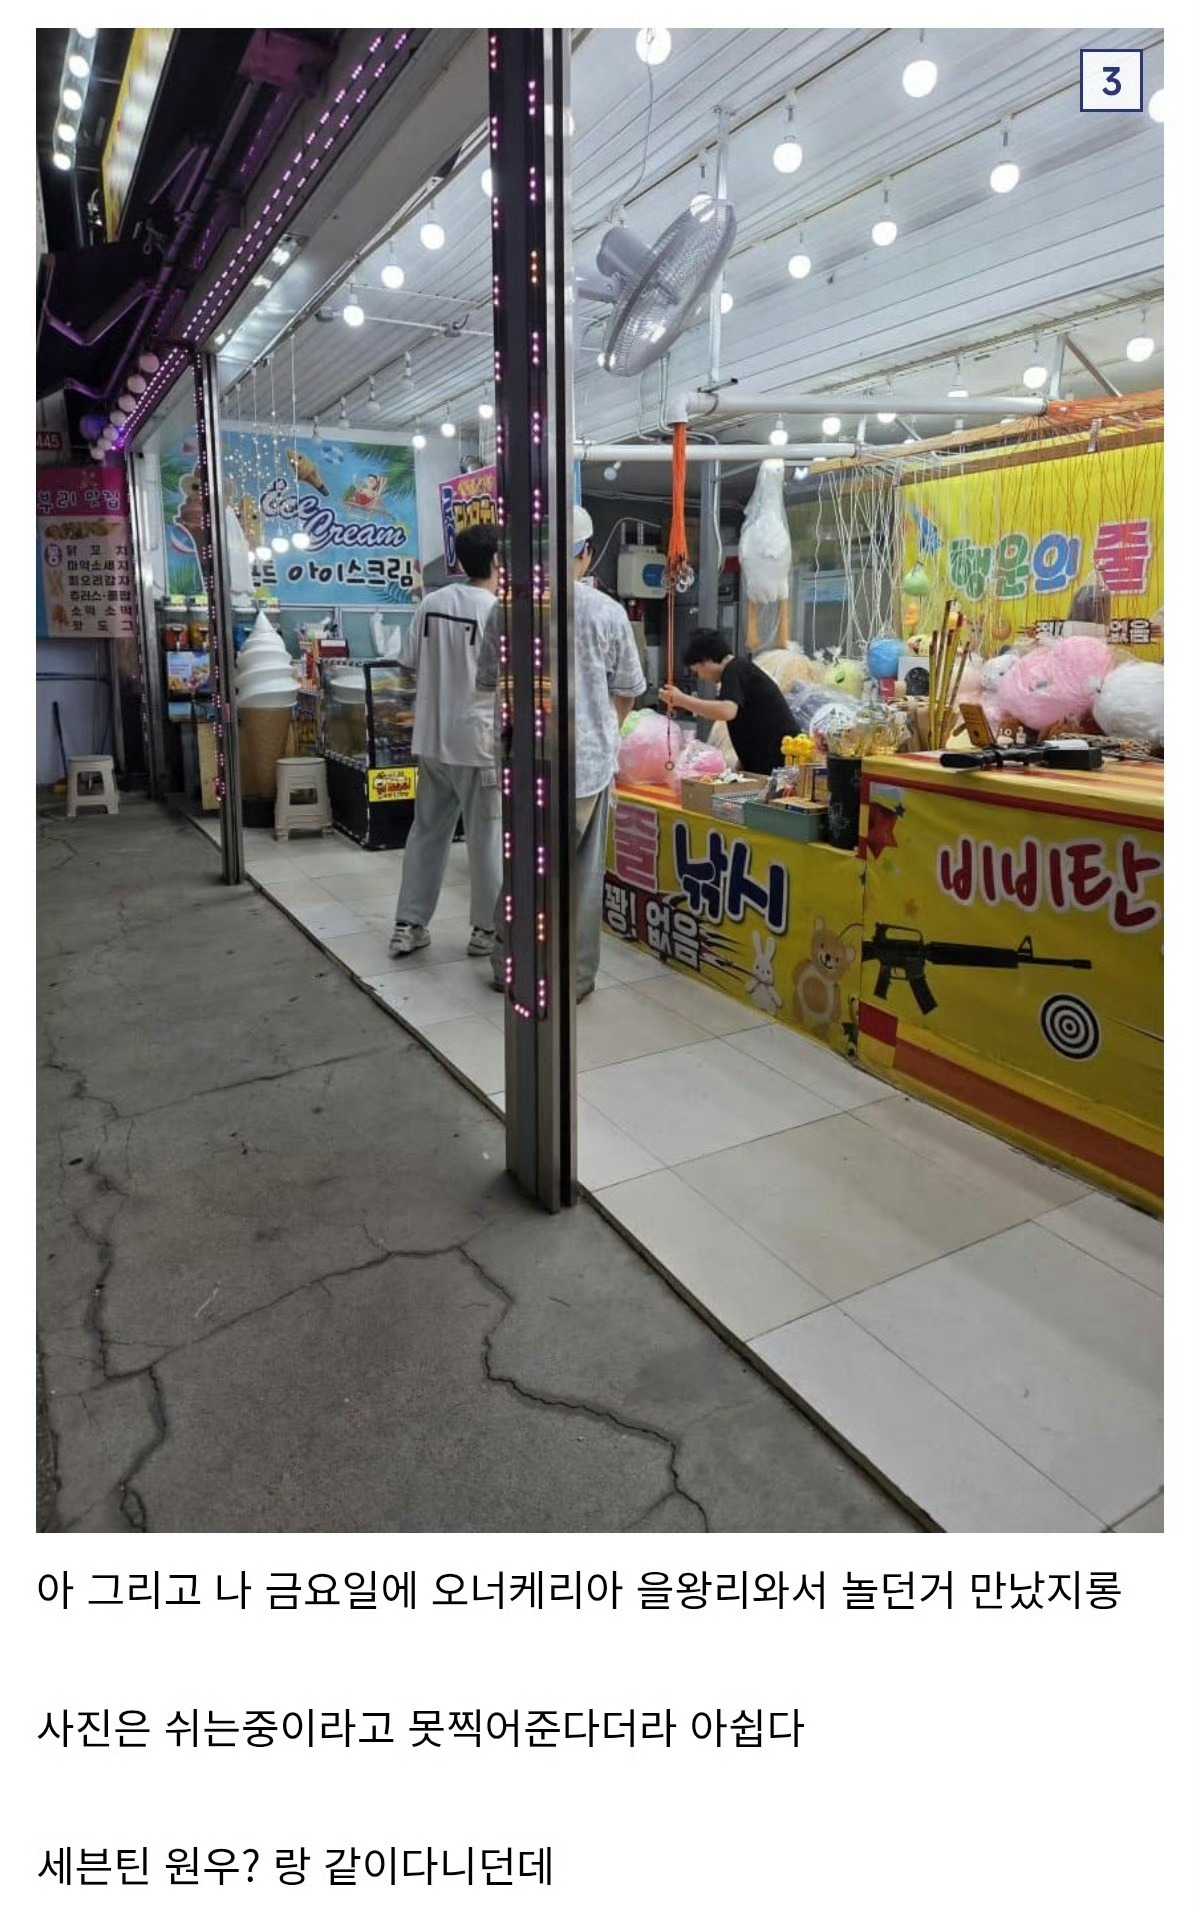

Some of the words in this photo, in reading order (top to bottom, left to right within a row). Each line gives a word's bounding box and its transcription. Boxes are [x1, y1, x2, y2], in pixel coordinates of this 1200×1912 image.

[303, 508, 407, 551] Cream
[949, 530, 1082, 600] 행운의
[1094, 519, 1152, 595] 줄
[288, 558, 414, 588] 아이스크림
[614, 803, 658, 894] 줄
[674, 820, 787, 934] 낚시
[936, 834, 1162, 932] 비비탄
[646, 901, 699, 968] 없음
